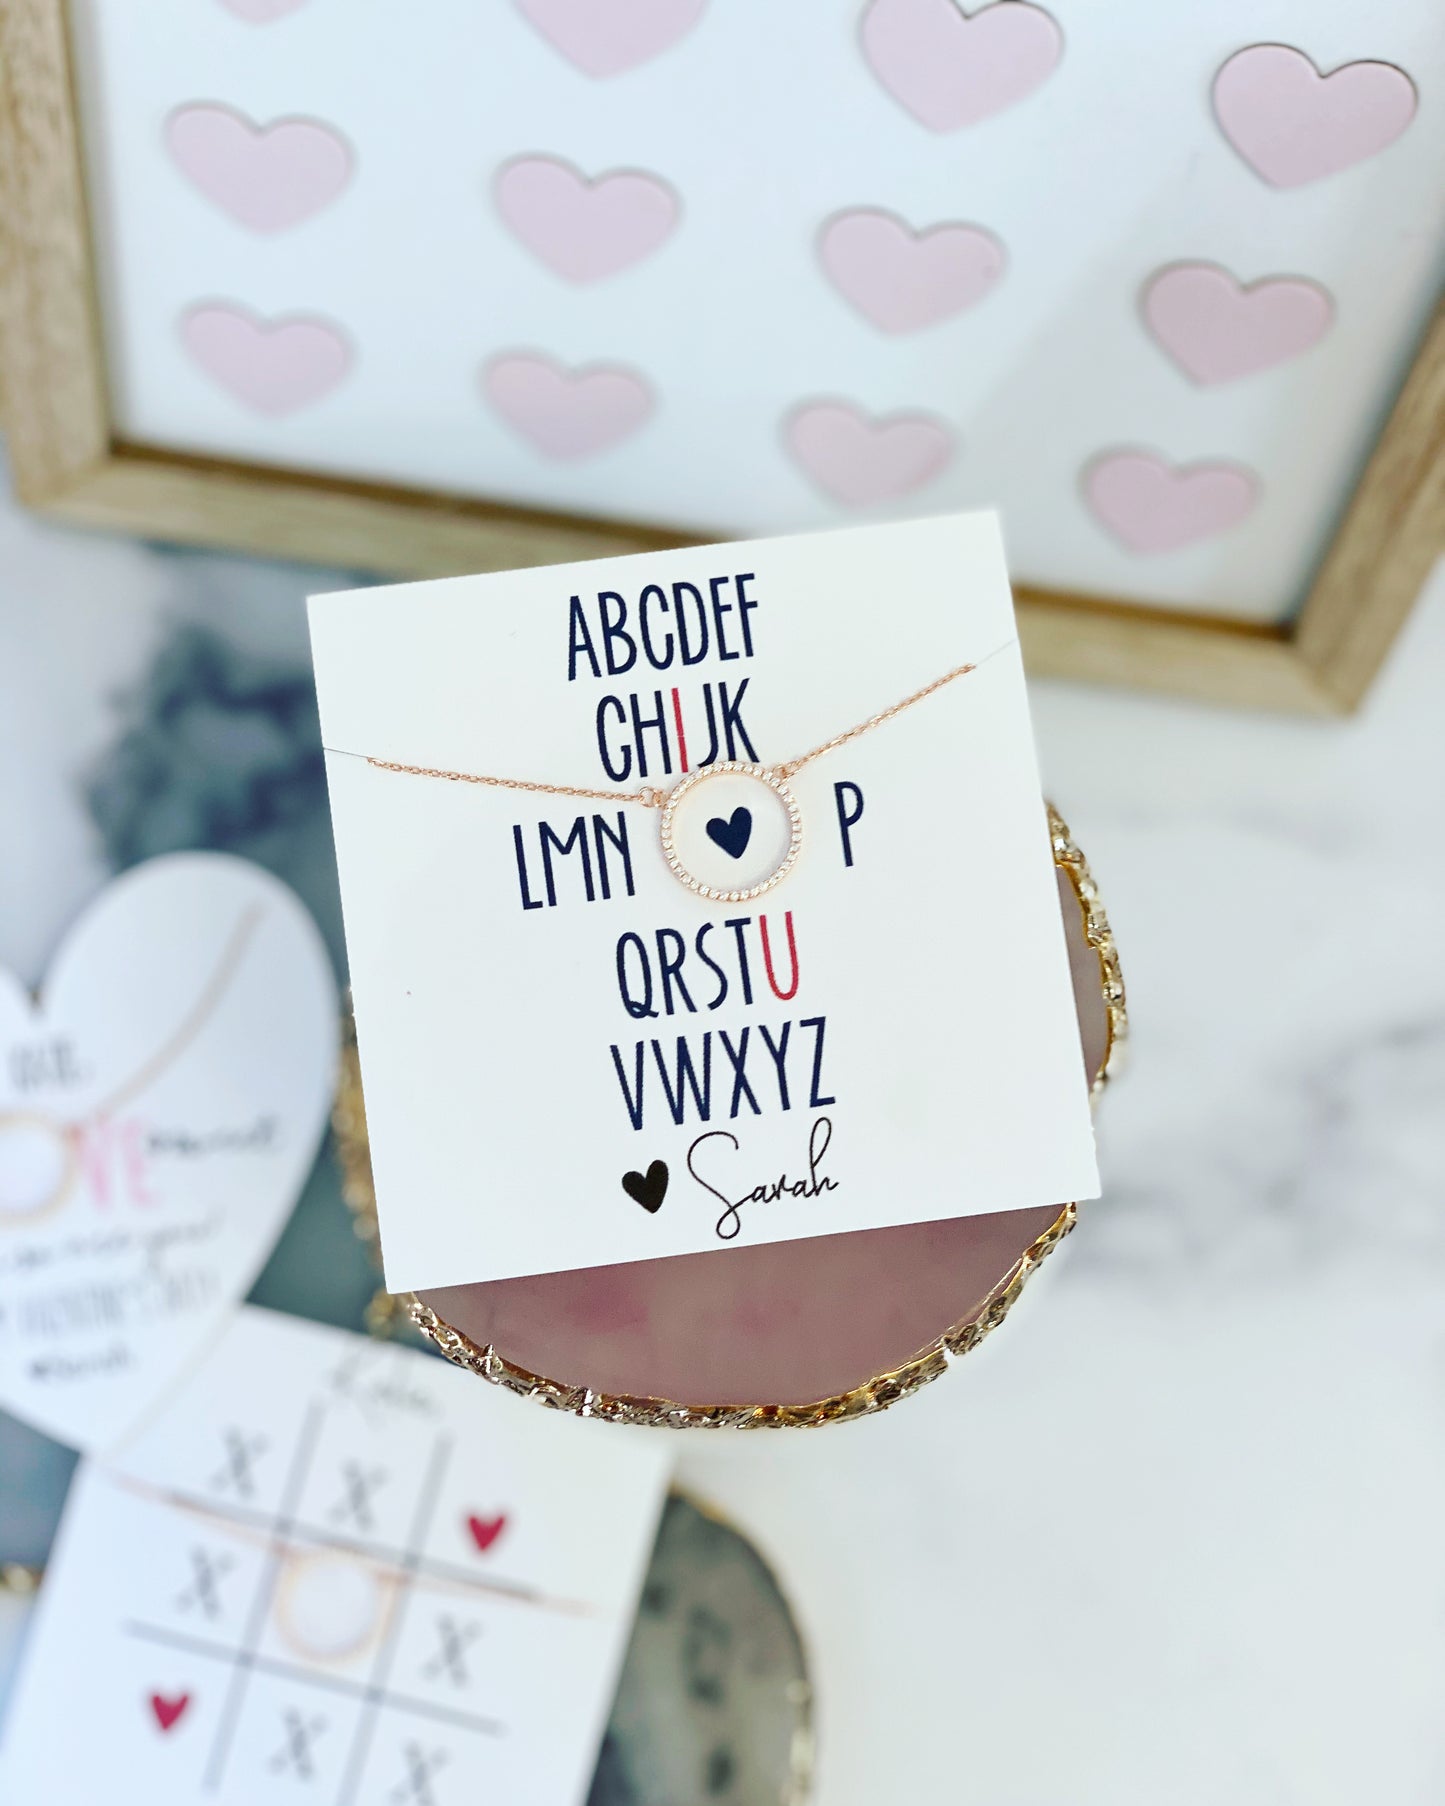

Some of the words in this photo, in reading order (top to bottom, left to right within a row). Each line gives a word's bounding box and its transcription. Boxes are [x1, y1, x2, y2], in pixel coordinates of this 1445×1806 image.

[567, 572, 759, 681] ABCDEF
[512, 811, 636, 911] LMN
[833, 781, 865, 868] P
[616, 910, 800, 1019] QRSTU
[609, 1016, 836, 1131] VWXYZ
[686, 1116, 840, 1240] Sarah
